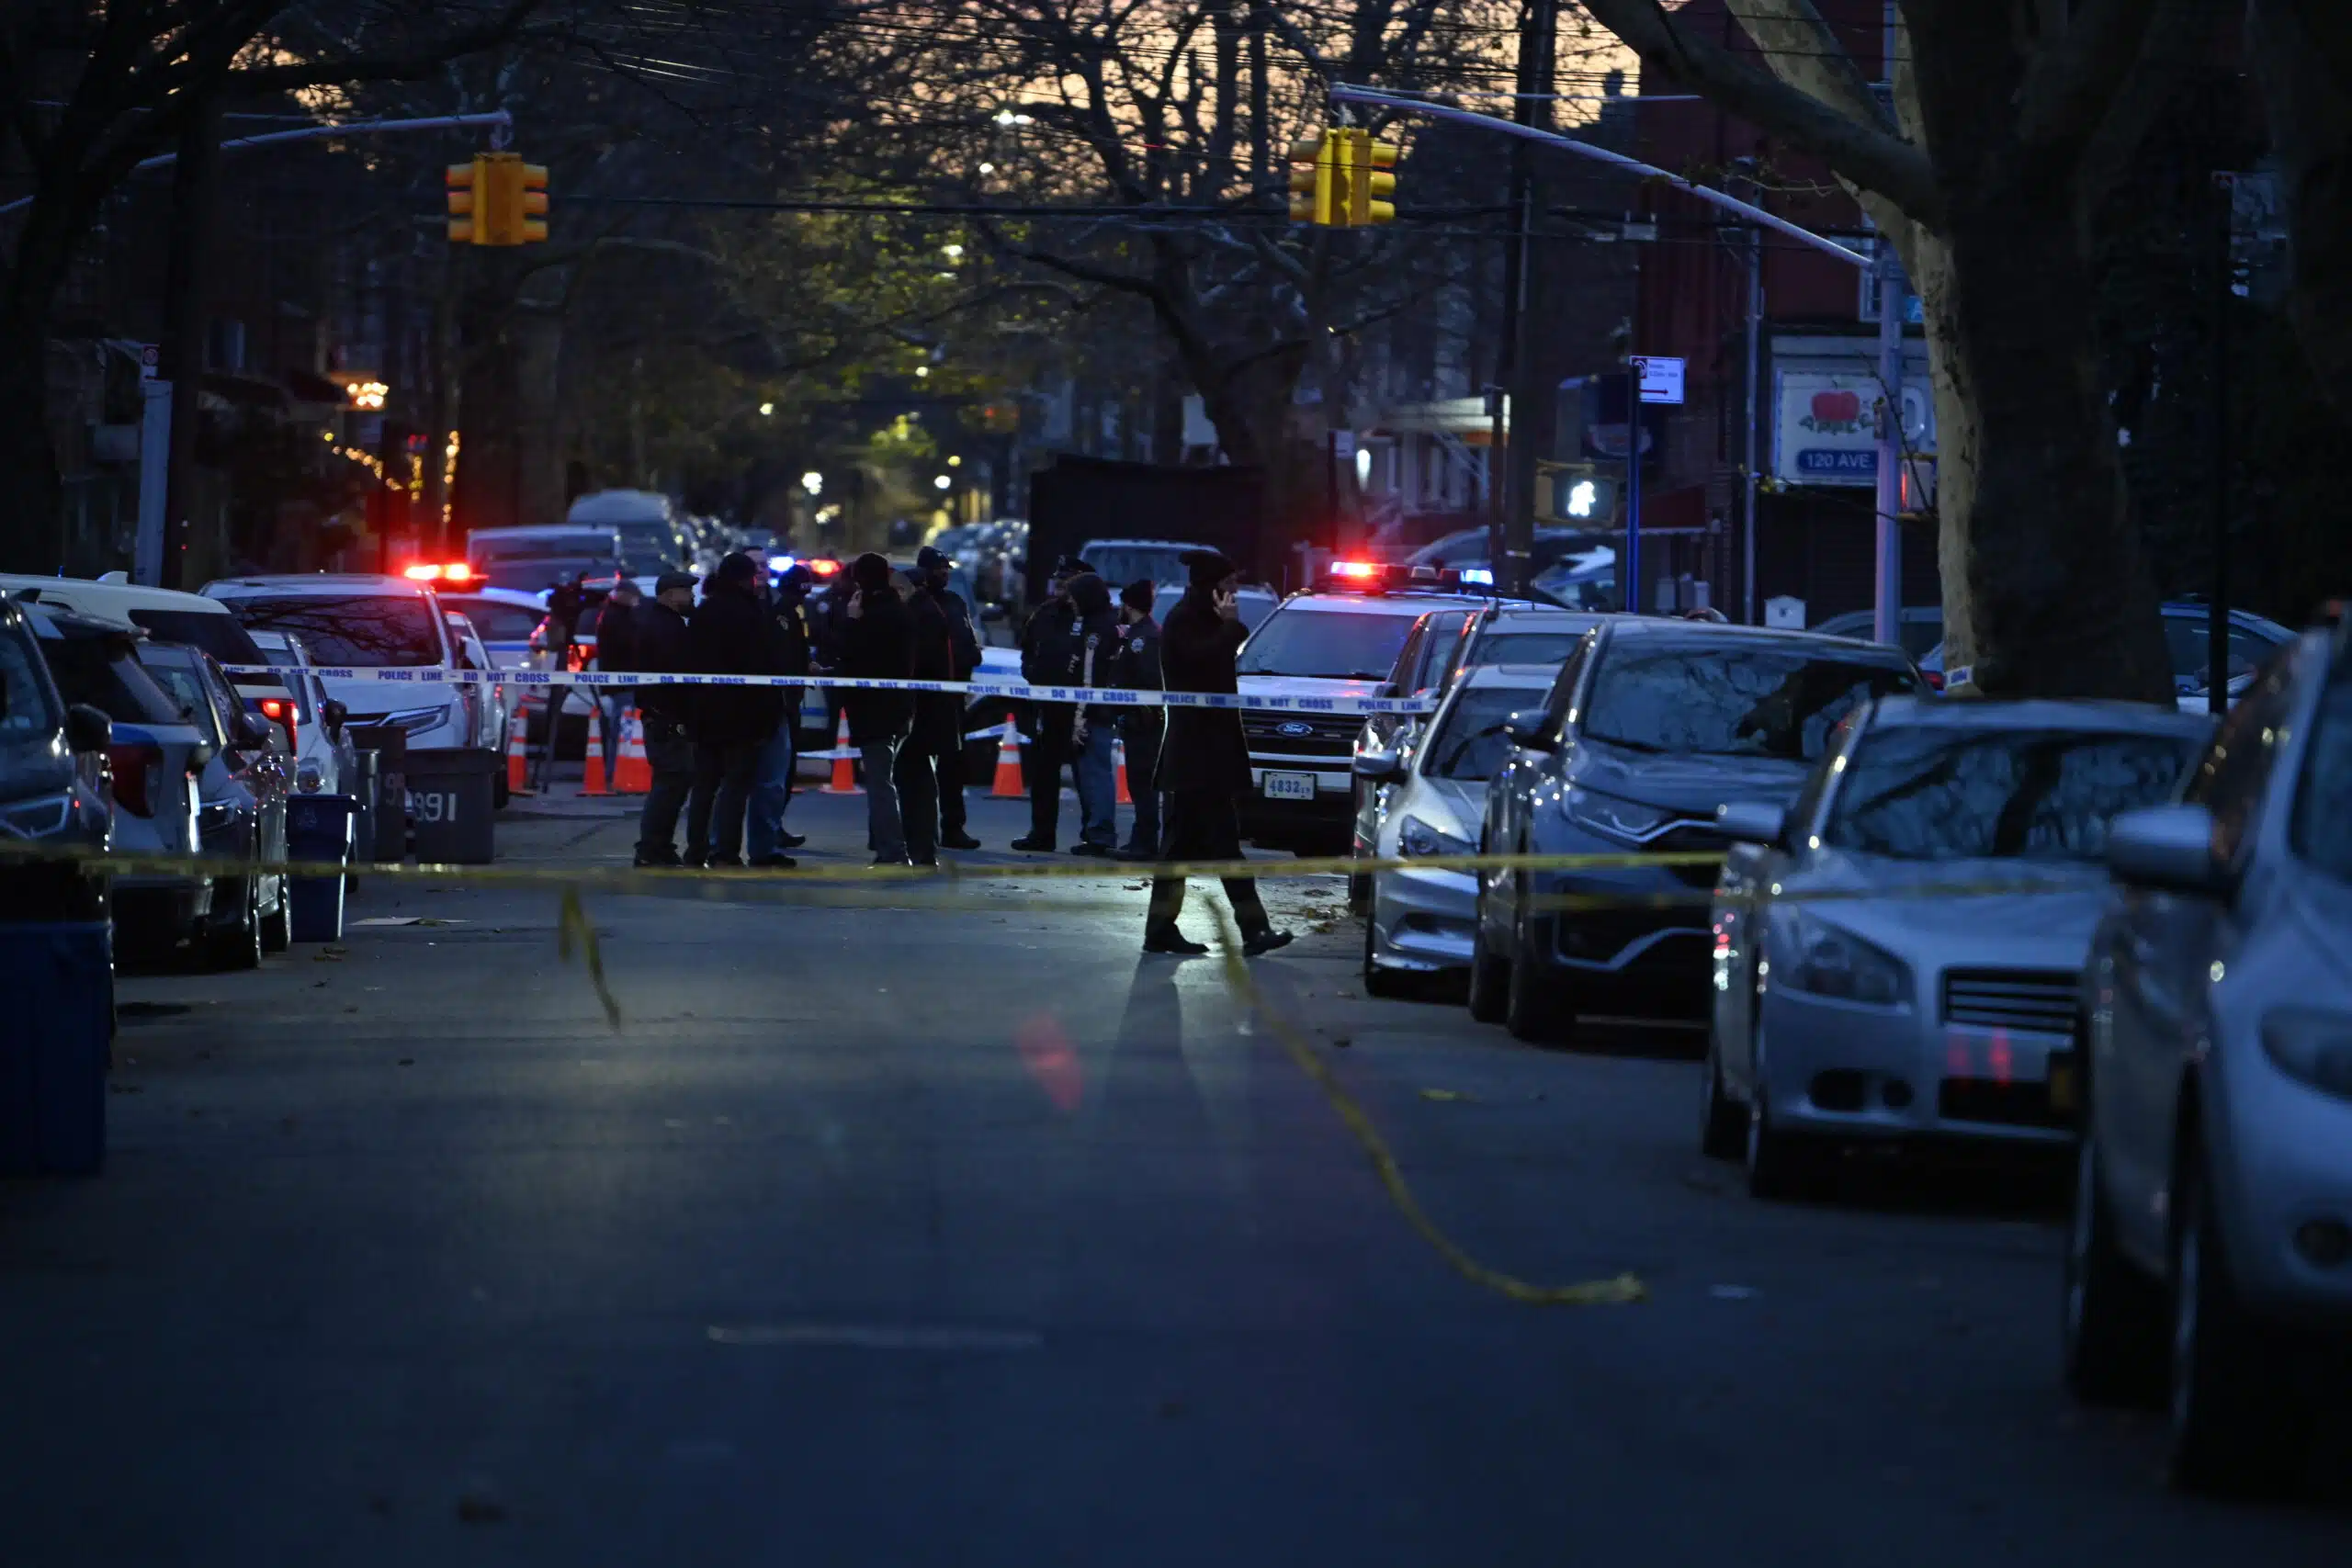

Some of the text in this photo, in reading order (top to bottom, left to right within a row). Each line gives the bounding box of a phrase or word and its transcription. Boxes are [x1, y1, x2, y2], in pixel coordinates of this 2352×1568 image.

[1806, 452, 1834, 468] 120
[318, 669, 353, 678] CROSS
[378, 670, 413, 681] POLICE
[421, 671, 443, 681] LINE
[463, 672, 479, 682] DO
[486, 672, 507, 682] NOT
[514, 672, 550, 683] CROSS
[574, 674, 610, 683] POLICE
[617, 675, 639, 684] LINE
[660, 676, 675, 684] DO
[683, 676, 703, 684] NOT
[711, 677, 746, 685] CROSS
[967, 685, 1001, 694] POLICE
[1009, 687, 1031, 696] LINE
[1051, 689, 1067, 699] DO
[1074, 690, 1094, 700] NOT
[1102, 691, 1137, 702] CROSS
[1161, 693, 1197, 705] POLICE
[1204, 695, 1227, 705] LINE
[1247, 696, 1261, 706] DO
[1269, 698, 1290, 707] NOT
[1298, 699, 1333, 710] CROSS
[1358, 699, 1393, 710] POLICE
[1401, 701, 1422, 710] LINE
[1269, 779, 1300, 794] 4832
[414, 792, 457, 822] 991
